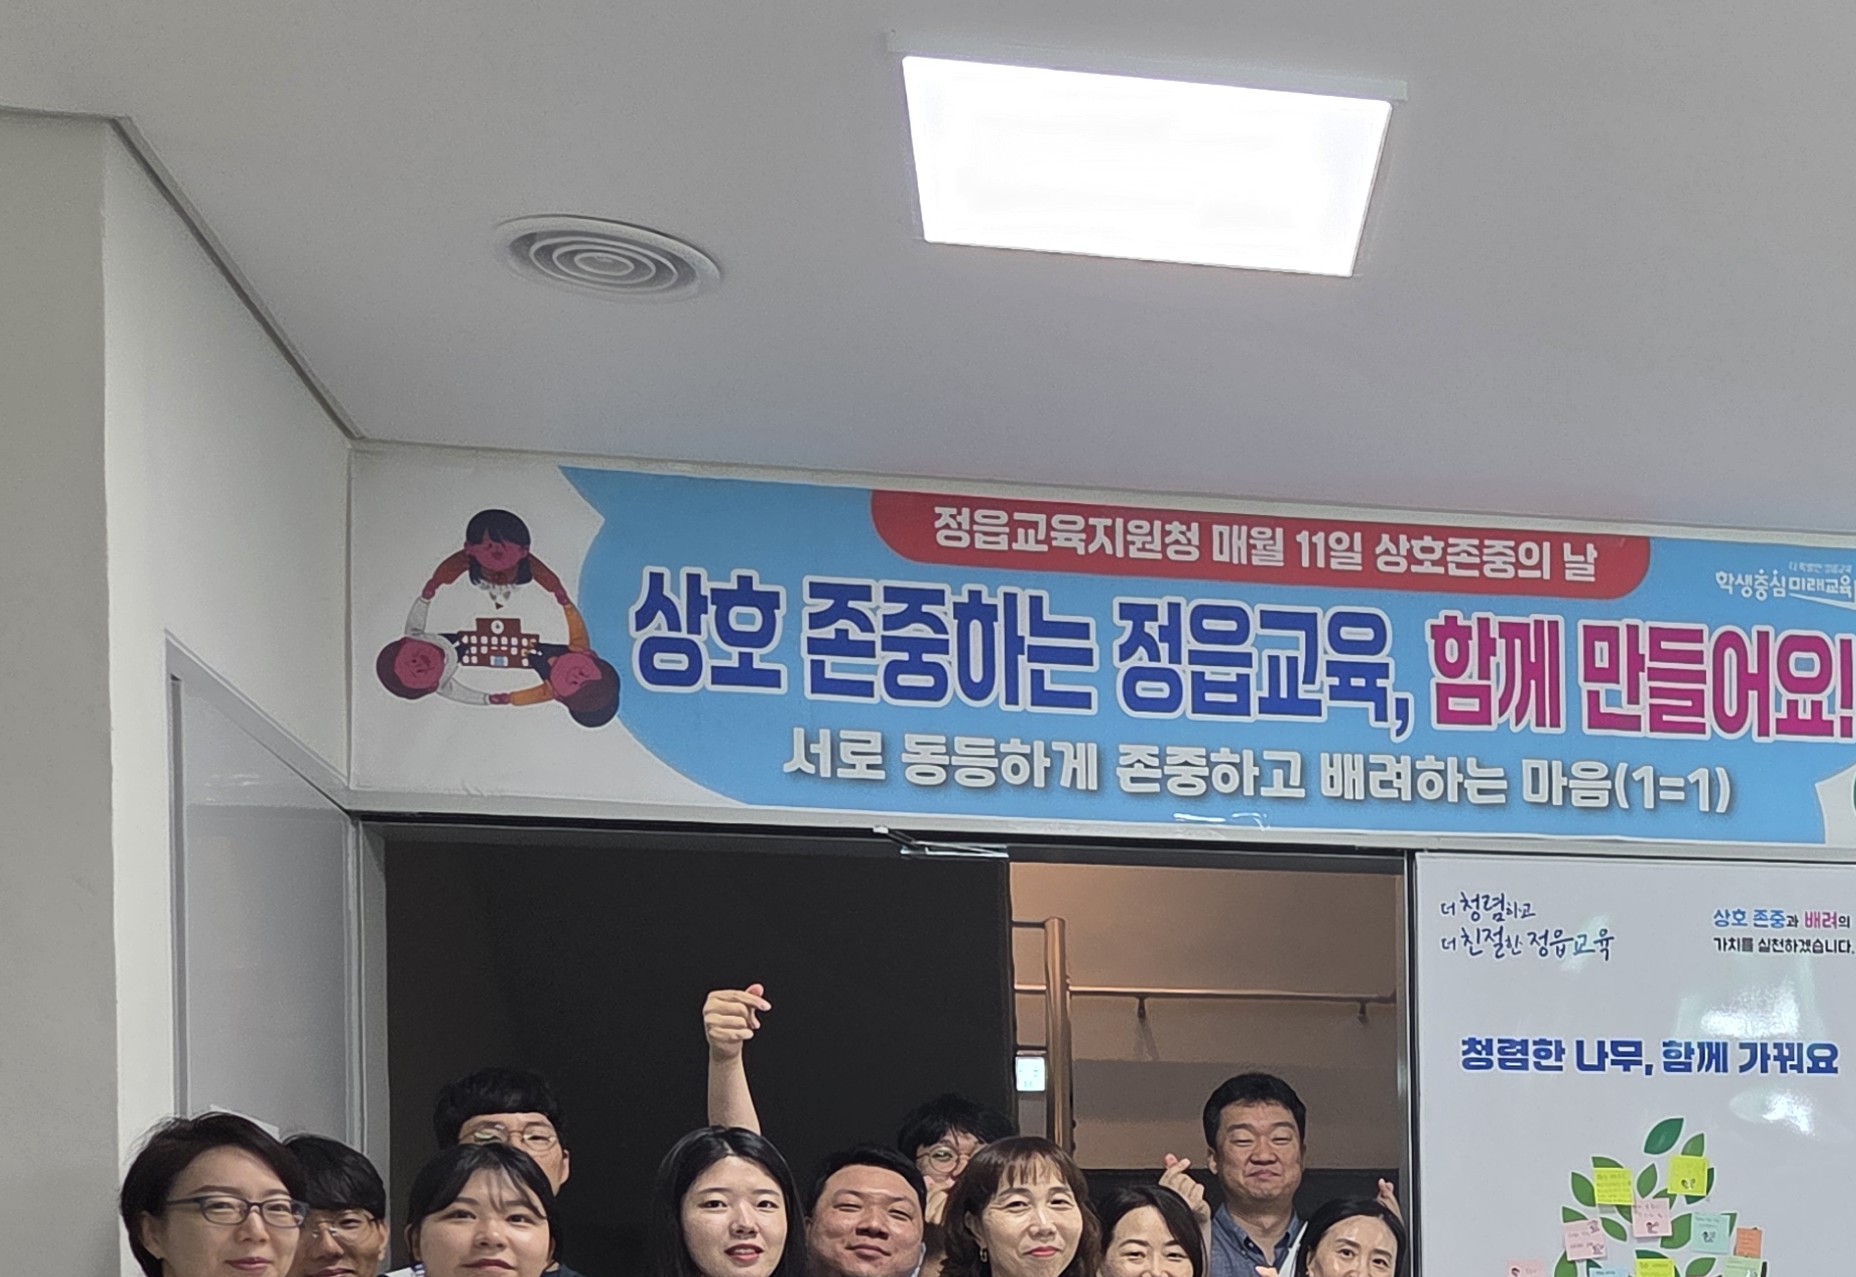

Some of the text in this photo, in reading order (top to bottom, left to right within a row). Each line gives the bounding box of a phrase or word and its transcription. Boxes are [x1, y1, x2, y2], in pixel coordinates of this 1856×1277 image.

[933, 505, 1599, 582] 정읍교육지원청 매월 11일 상호존중의 날
[1715, 568, 1853, 601] 학생중심 미래교육
[633, 568, 1856, 740] 상호 존중하는 정읍교육, 함께 만들어요!
[783, 728, 1732, 814] 서로 동등하게 존중하고 배려하는 마음(1=1)
[1440, 891, 1536, 922] 더 청렴하고
[1713, 908, 1851, 929] 상호 존중과 배려의
[1441, 926, 1615, 962] 더 친절한 정읍교육
[1713, 936, 1856, 954] 가치를 실천하겠습니다.
[1460, 1036, 1839, 1077] 청렴한 나무, 함께 가꿔요
